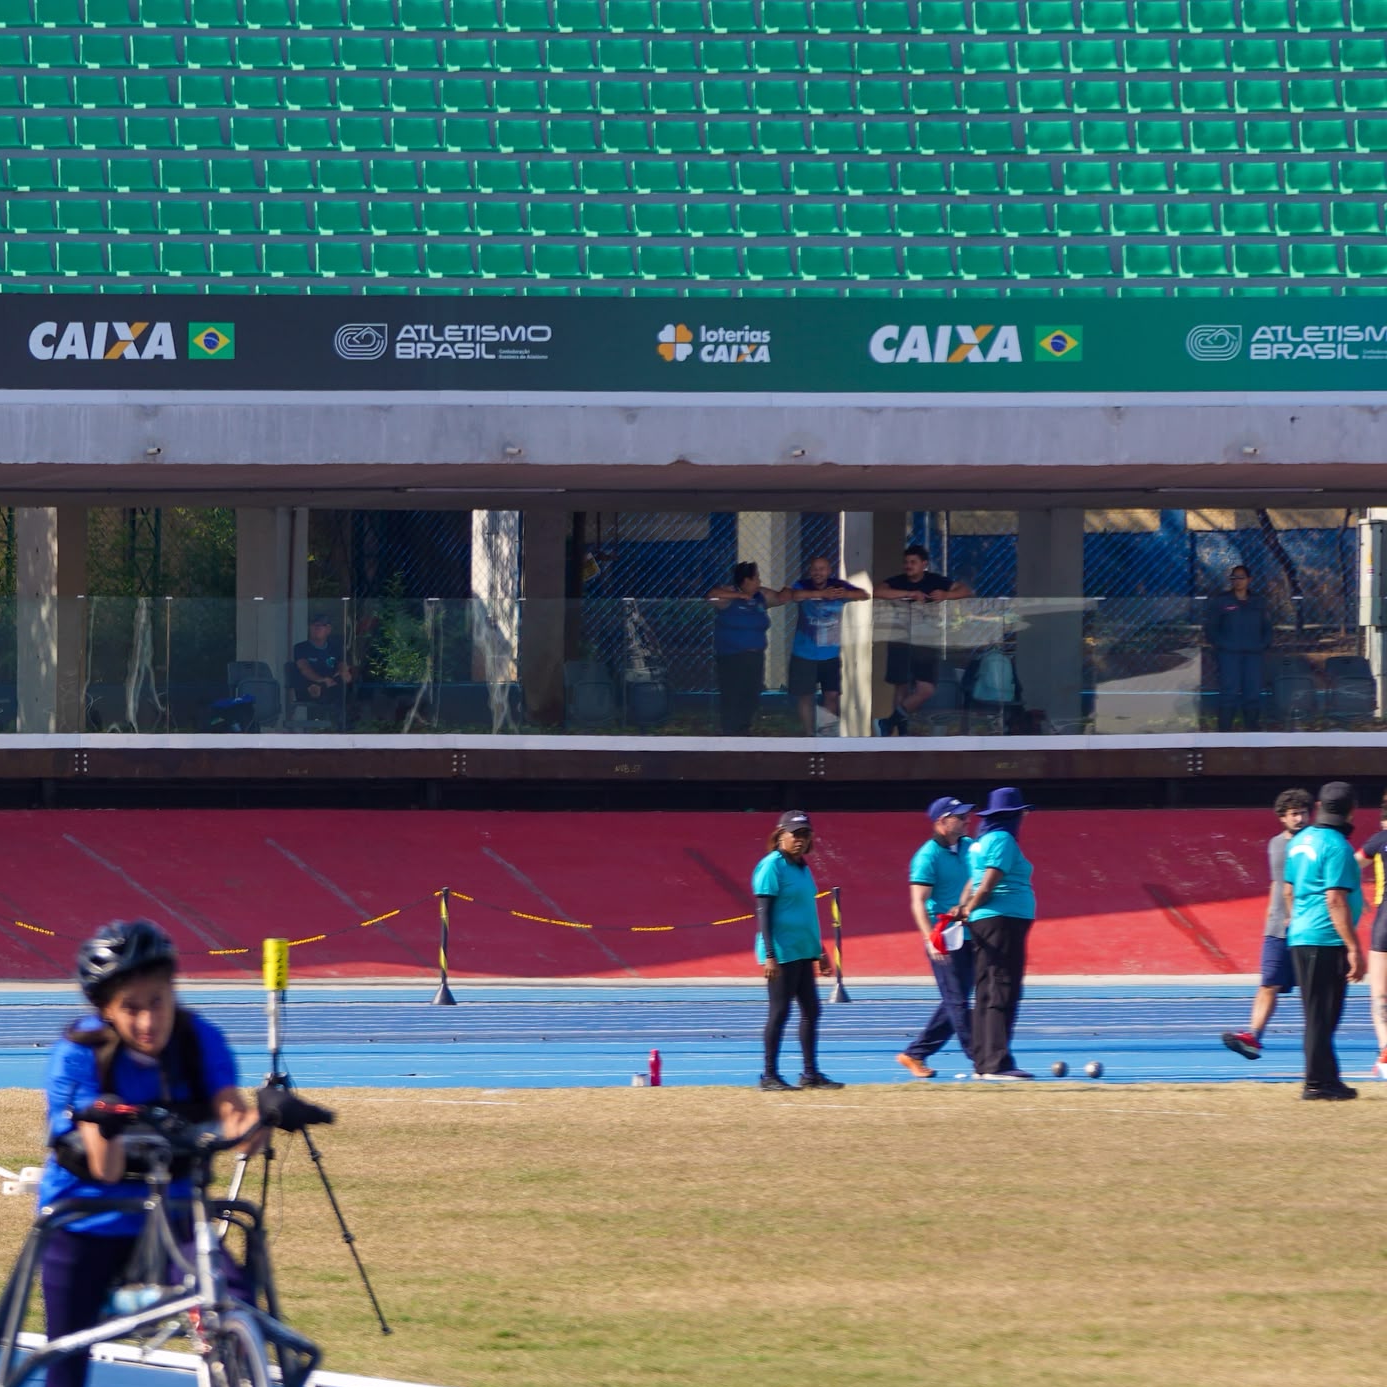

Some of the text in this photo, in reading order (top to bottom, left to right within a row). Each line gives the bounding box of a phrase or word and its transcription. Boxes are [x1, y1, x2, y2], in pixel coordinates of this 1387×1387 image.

[28, 321, 177, 360] CAIXA
[395, 324, 553, 342] ATLETISMO
[700, 325, 771, 343] loterias
[395, 342, 496, 359] BRASIL
[869, 324, 1023, 363] CAIXA
[1249, 343, 1359, 360] BRASIL
[700, 344, 771, 363] CAIXA
